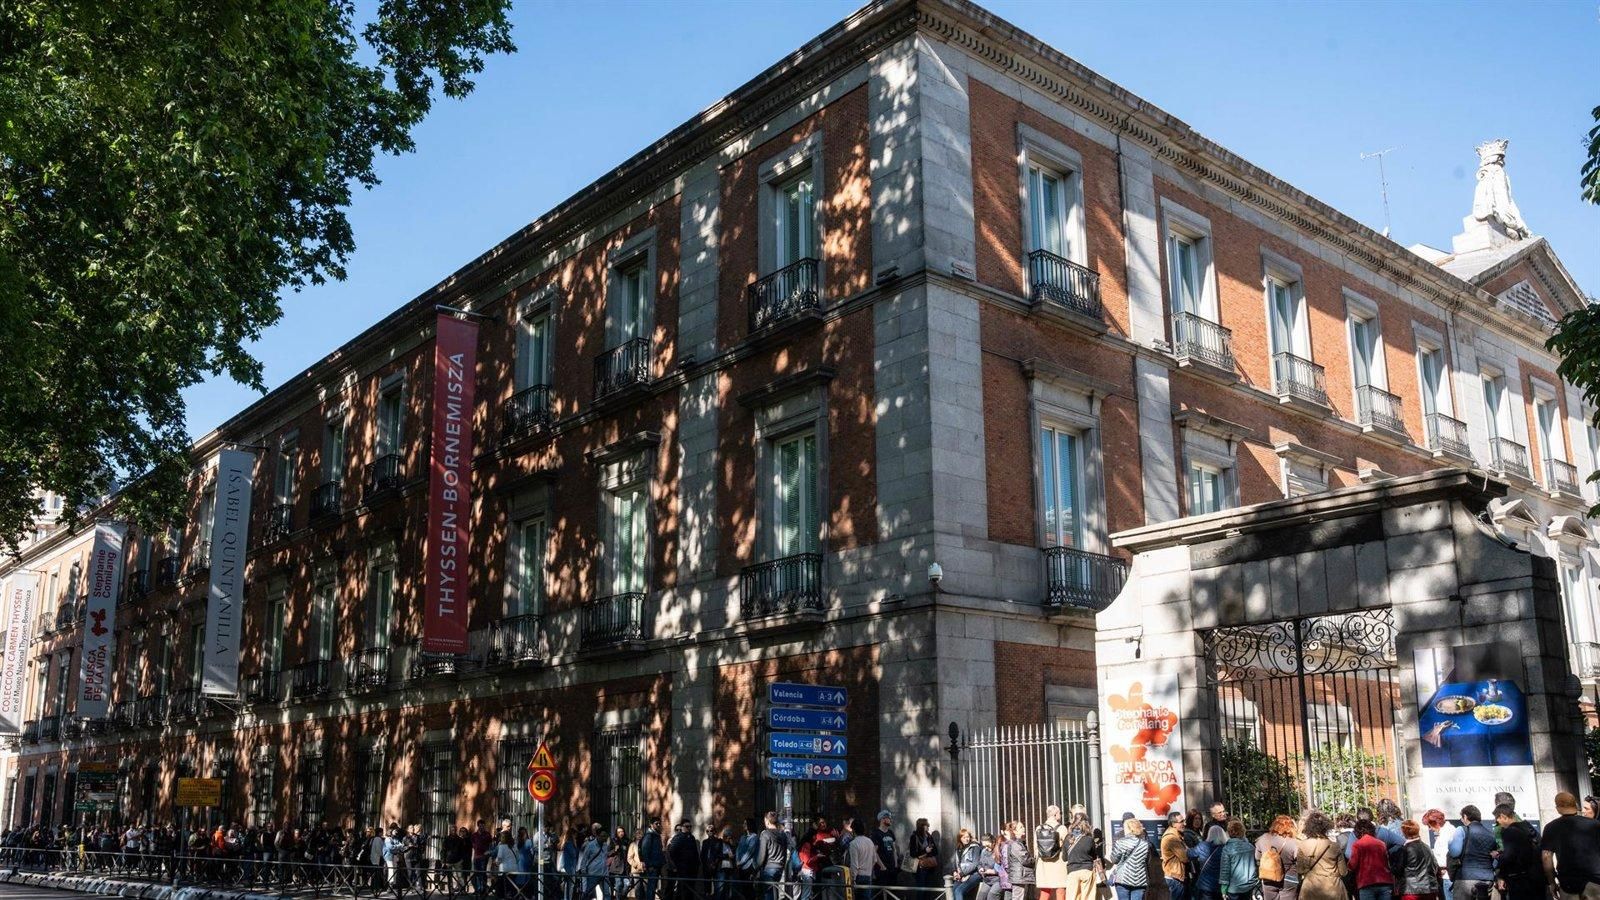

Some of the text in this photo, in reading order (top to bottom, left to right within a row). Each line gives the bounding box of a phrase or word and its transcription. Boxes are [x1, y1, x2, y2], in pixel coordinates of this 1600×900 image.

[439, 353, 464, 616] THYSSEN-BORNEMISZA
[225, 468, 242, 526] ISABEL
[1194, 546, 1234, 562] MUSEO
[93, 549, 106, 598] Stephanie
[102, 552, 117, 598] Comilang
[216, 532, 237, 655] QUINTANILLA
[2, 588, 23, 712] COLECCIÓN CARMEN THYSSEN
[16, 649, 24, 675] Nacional
[93, 645, 106, 701] DE LA VIDA
[84, 649, 97, 701] EN BUSCA
[13, 677, 21, 697] Museo
[773, 689, 832, 700] Valencia A-3
[773, 713, 806, 723] Córdoba
[773, 740, 798, 748] Toledo
[1115, 772, 1177, 784] DE LA VIDA
[1117, 760, 1174, 773] EN BUSCA
[535, 780, 551, 791] 30
[1436, 785, 1525, 794] ISABEL QUINTANILLA
